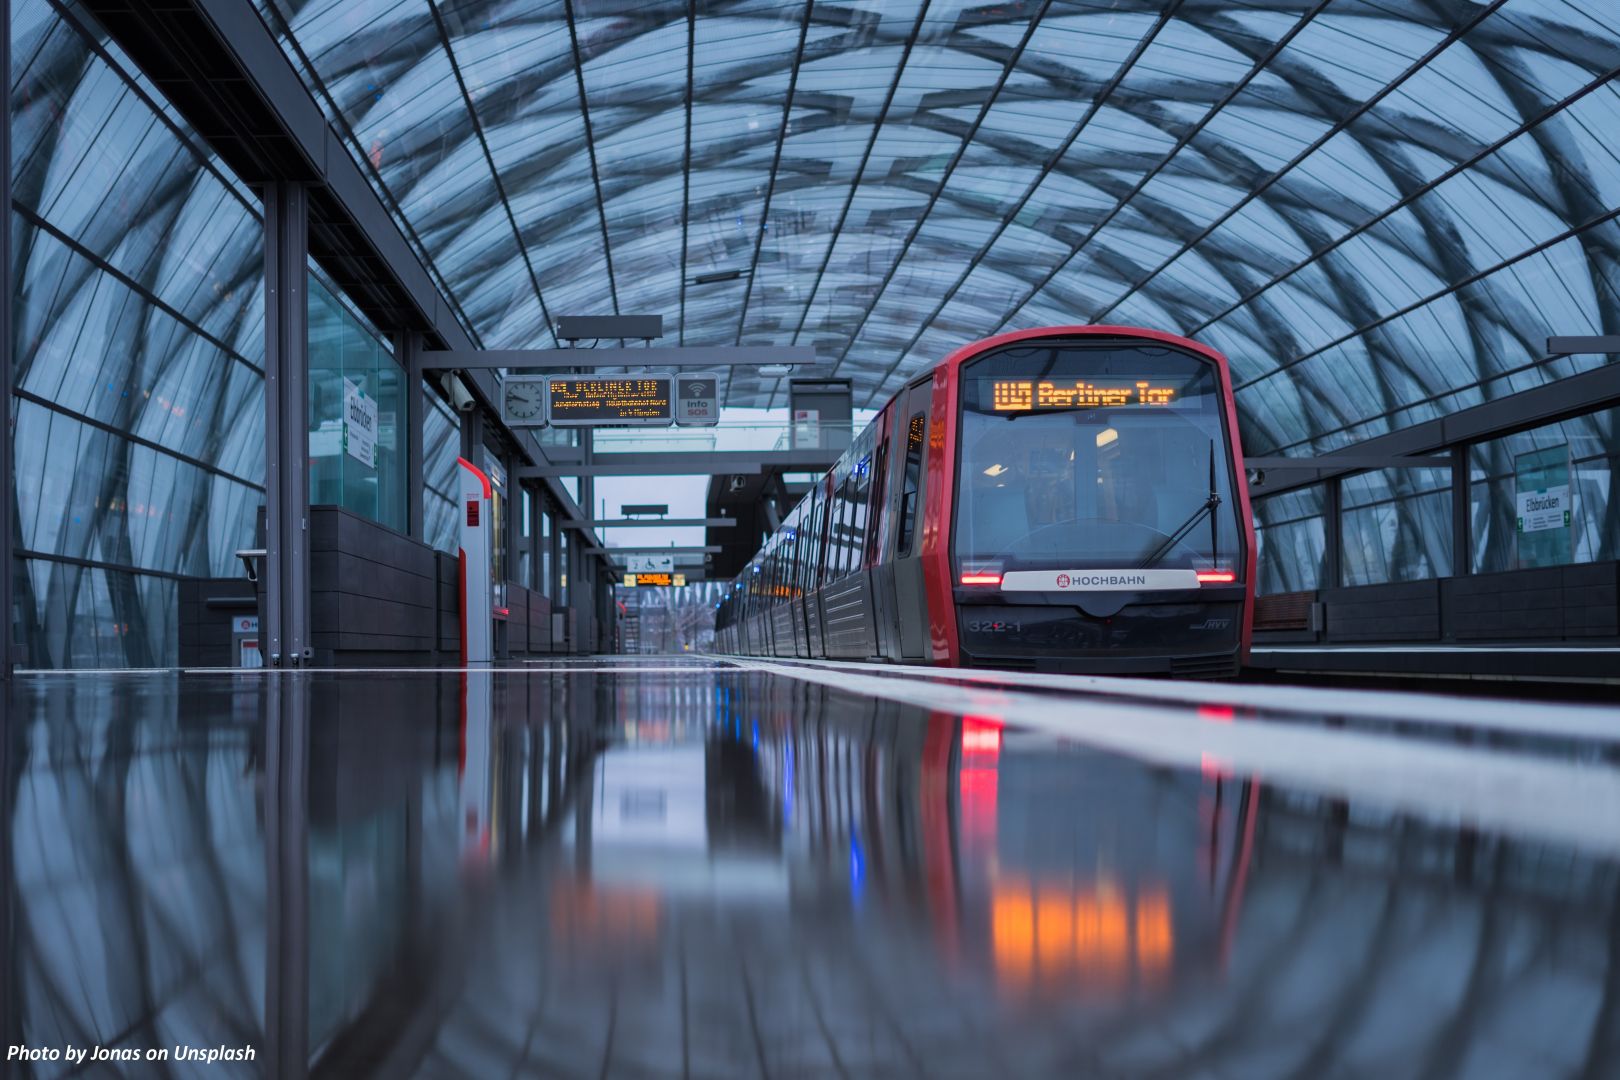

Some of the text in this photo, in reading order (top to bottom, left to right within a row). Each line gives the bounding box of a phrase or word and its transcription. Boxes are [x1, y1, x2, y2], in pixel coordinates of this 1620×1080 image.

[637, 380, 658, 391] TOR
[1038, 382, 1131, 406] Berliner
[1136, 382, 1174, 406] Tor
[687, 400, 708, 408] Info
[350, 396, 371, 432] Elbbrücken
[1526, 496, 1560, 512] Elbbrücken
[1072, 575, 1146, 587] HOCHBAHN
[969, 621, 1021, 632] 322-1
